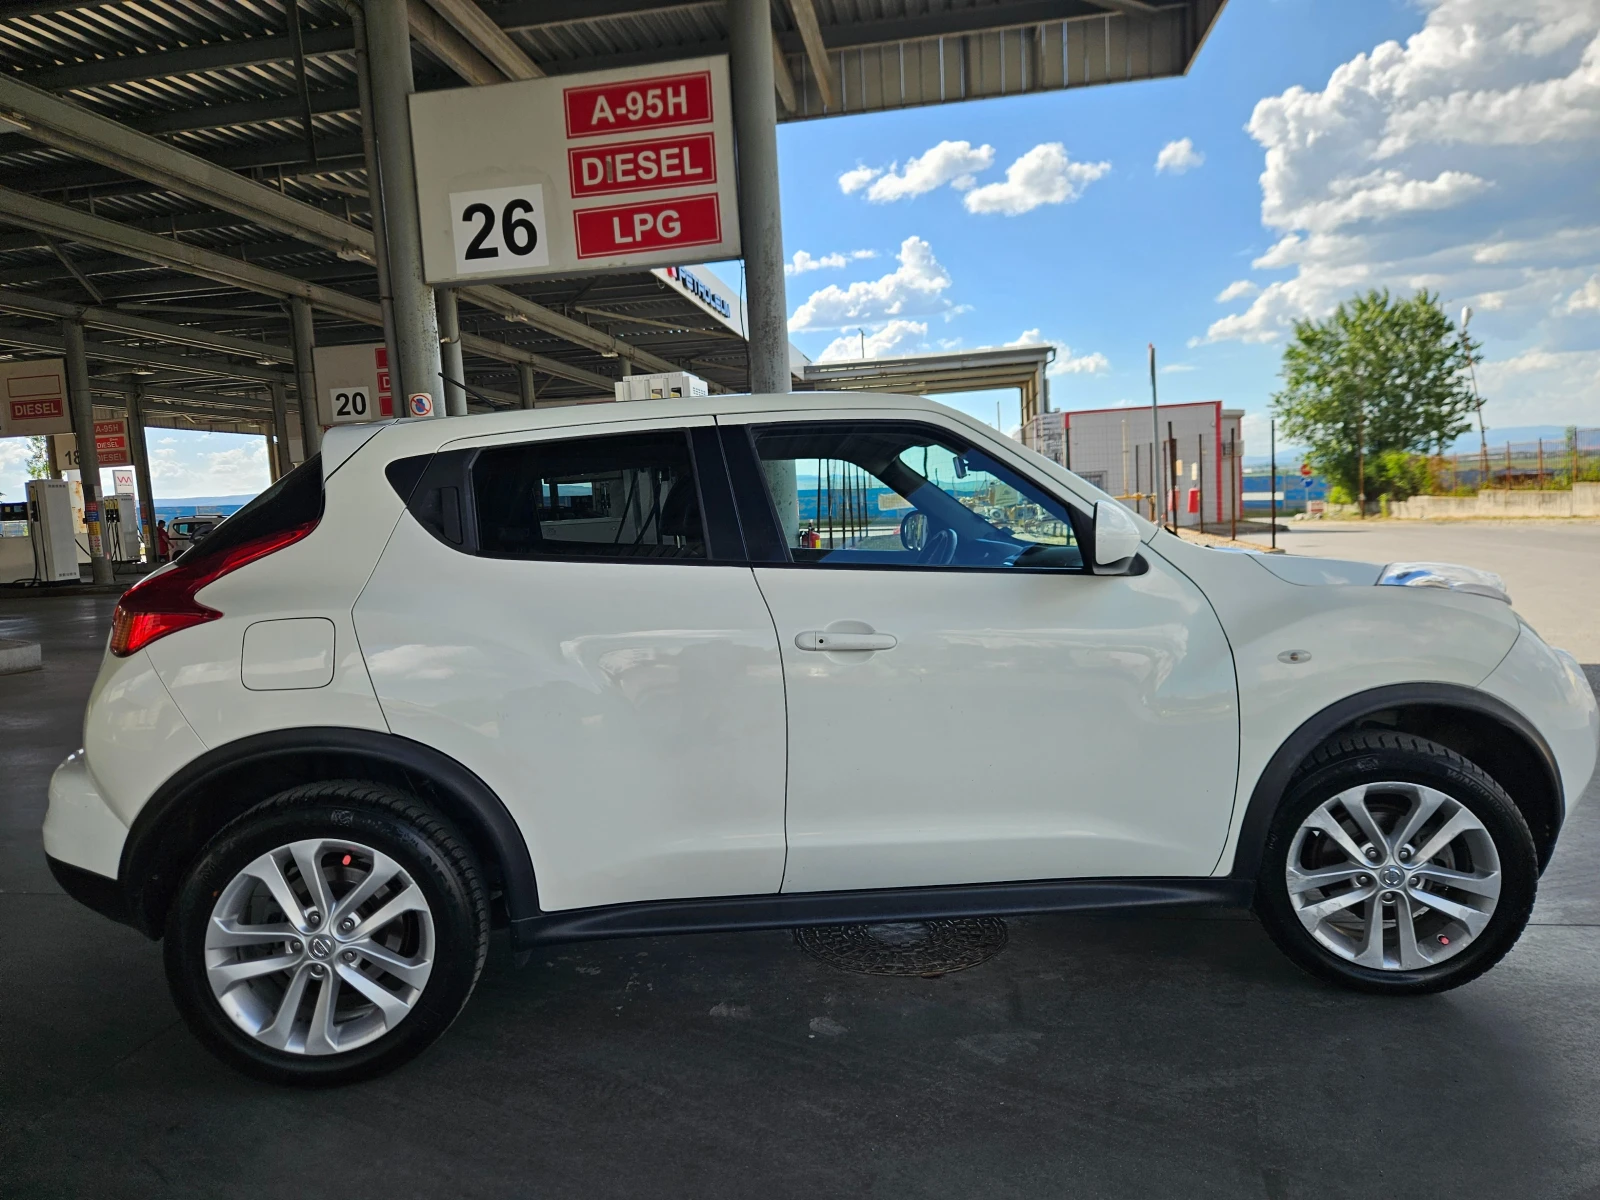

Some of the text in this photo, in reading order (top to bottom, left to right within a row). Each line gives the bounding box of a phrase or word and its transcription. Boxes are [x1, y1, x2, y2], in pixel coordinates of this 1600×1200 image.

[591, 85, 687, 125] A-95H
[581, 147, 703, 187] DIESEL
[462, 198, 538, 261] 26
[612, 210, 682, 244] LPG
[14, 403, 59, 416] DIESEL
[335, 391, 367, 417] 20
[95, 424, 119, 433] A-95H
[96, 441, 120, 449] DIESEL
